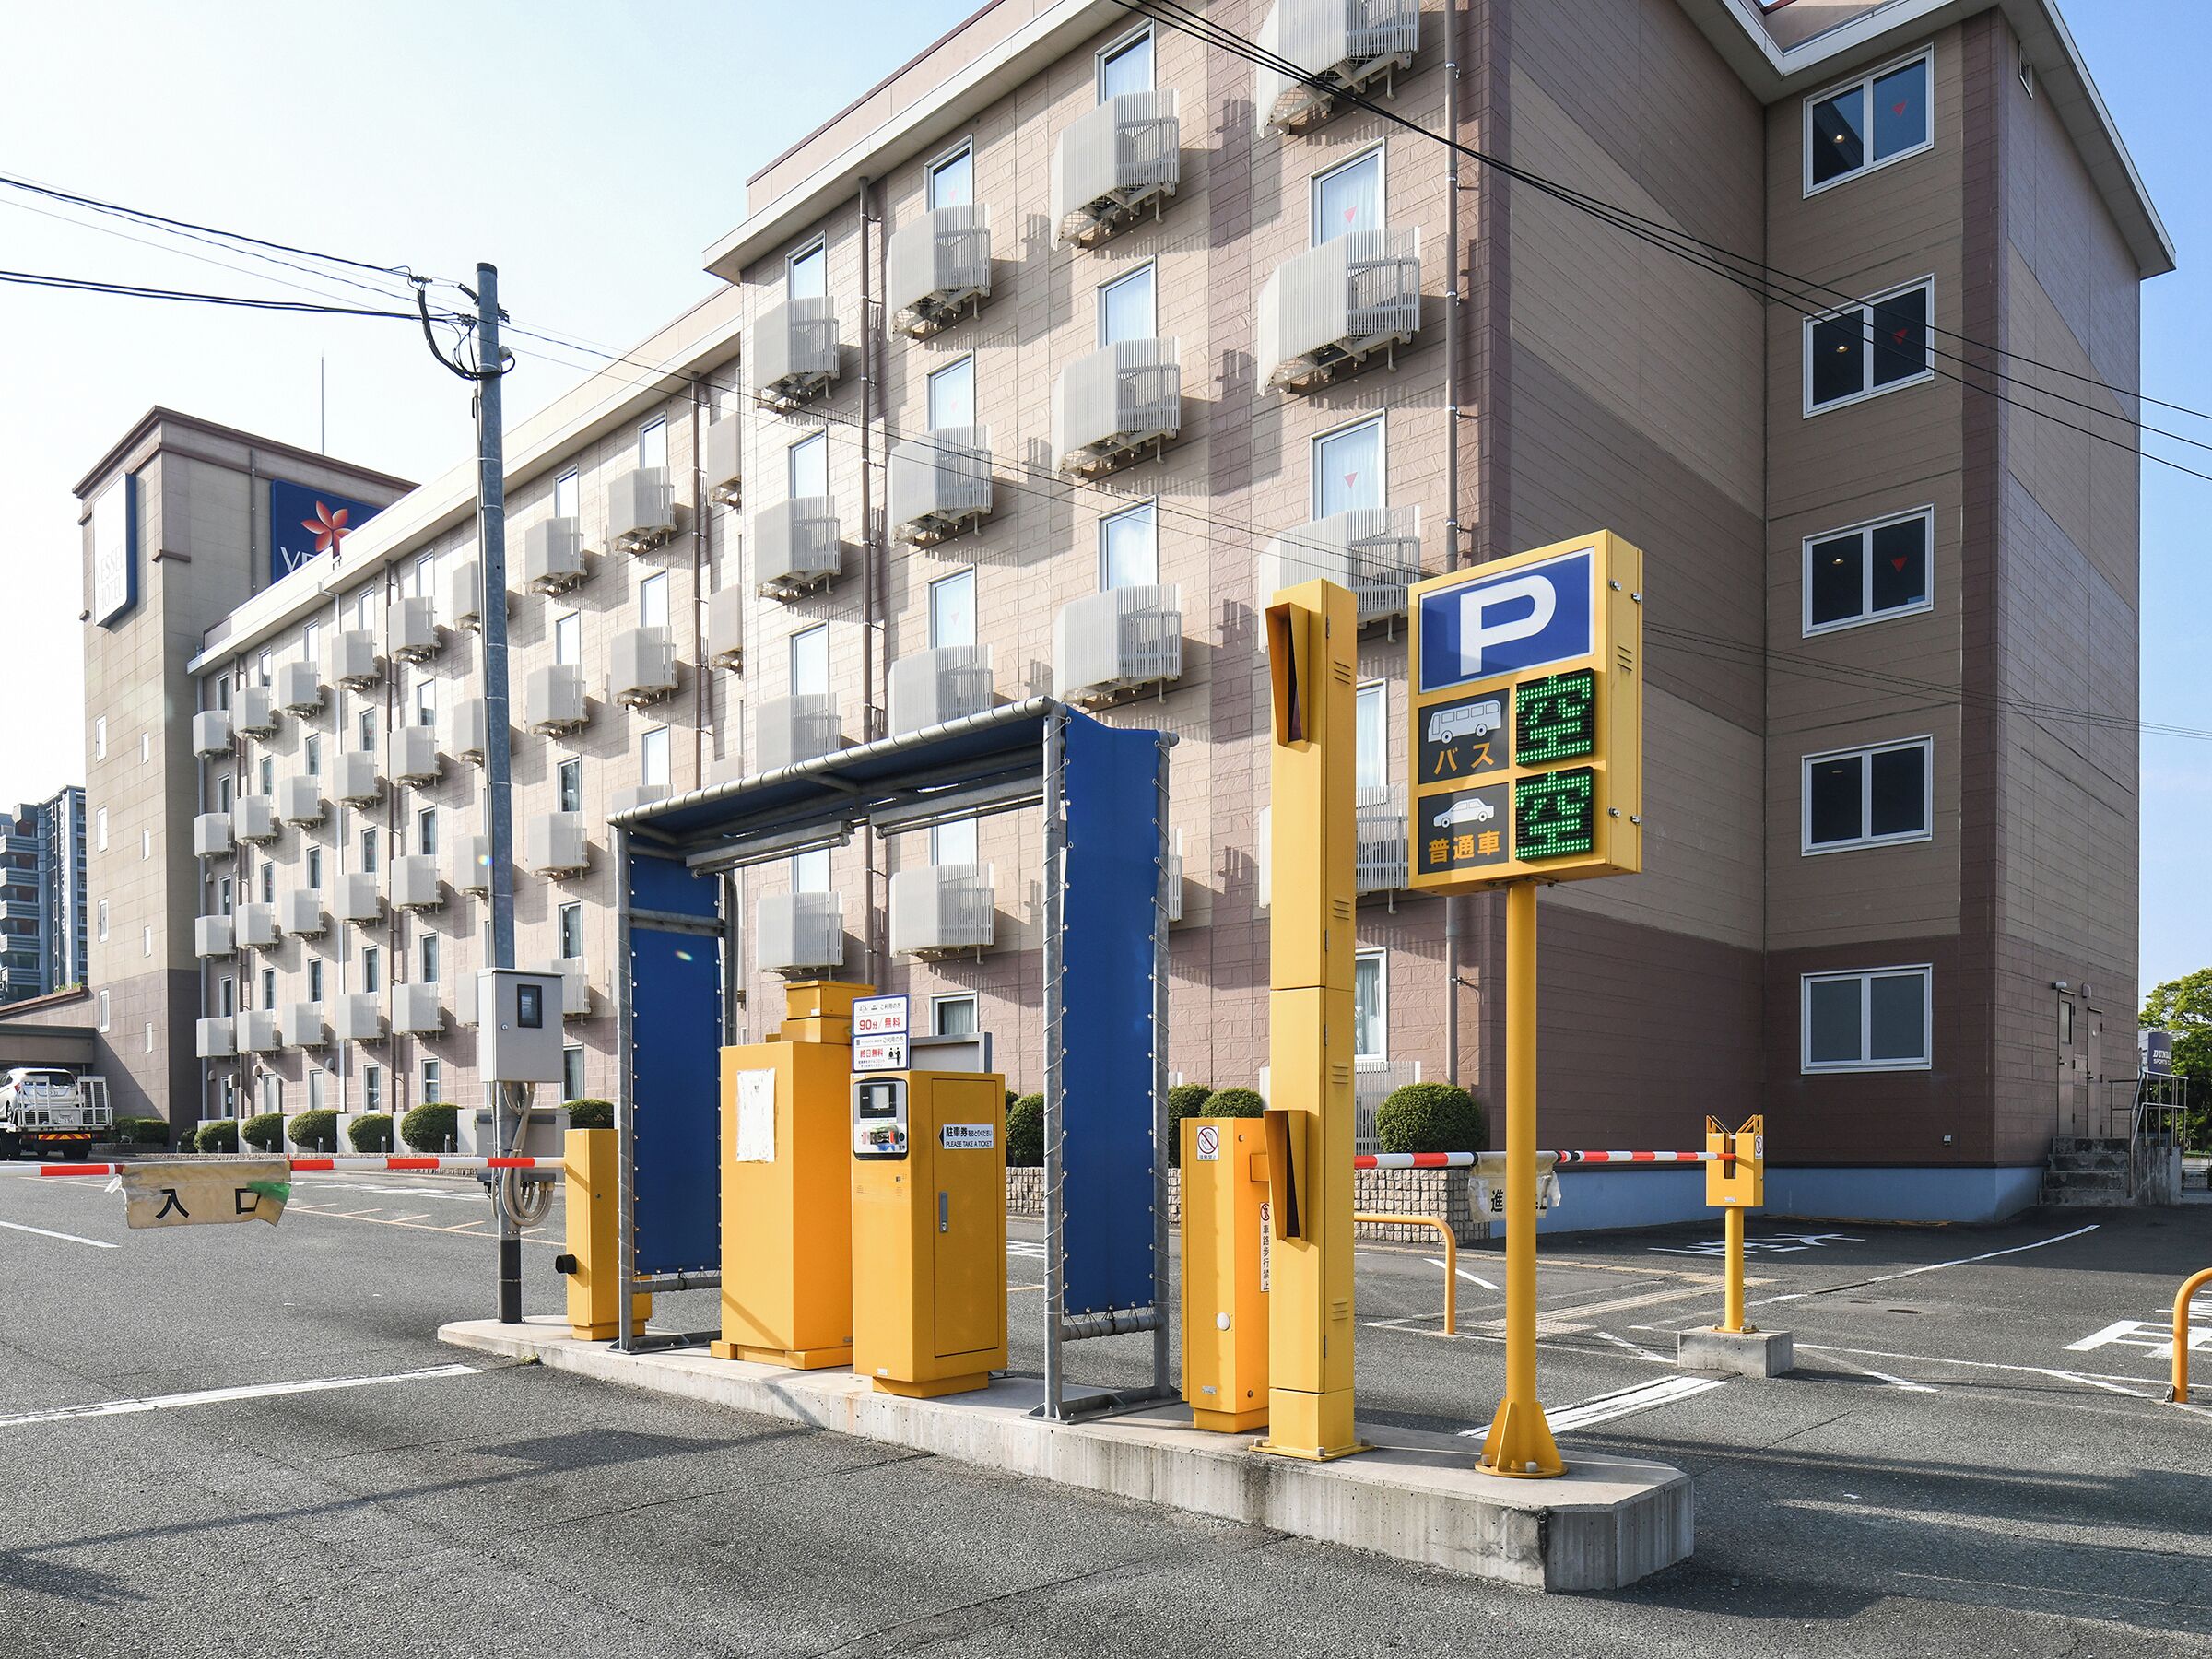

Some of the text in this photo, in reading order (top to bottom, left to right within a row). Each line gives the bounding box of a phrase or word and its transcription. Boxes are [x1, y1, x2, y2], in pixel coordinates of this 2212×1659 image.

[96, 544, 124, 584] VESSEL
[99, 574, 123, 612] HOTEL
[1460, 575, 1557, 677] P
[1516, 674, 1592, 763] 空
[1433, 742, 1495, 775] バス
[1516, 771, 1592, 859] 空
[1428, 830, 1501, 865] 普通車
[860, 1048, 884, 1058] 終日無料
[155, 1188, 261, 1220] 入口
